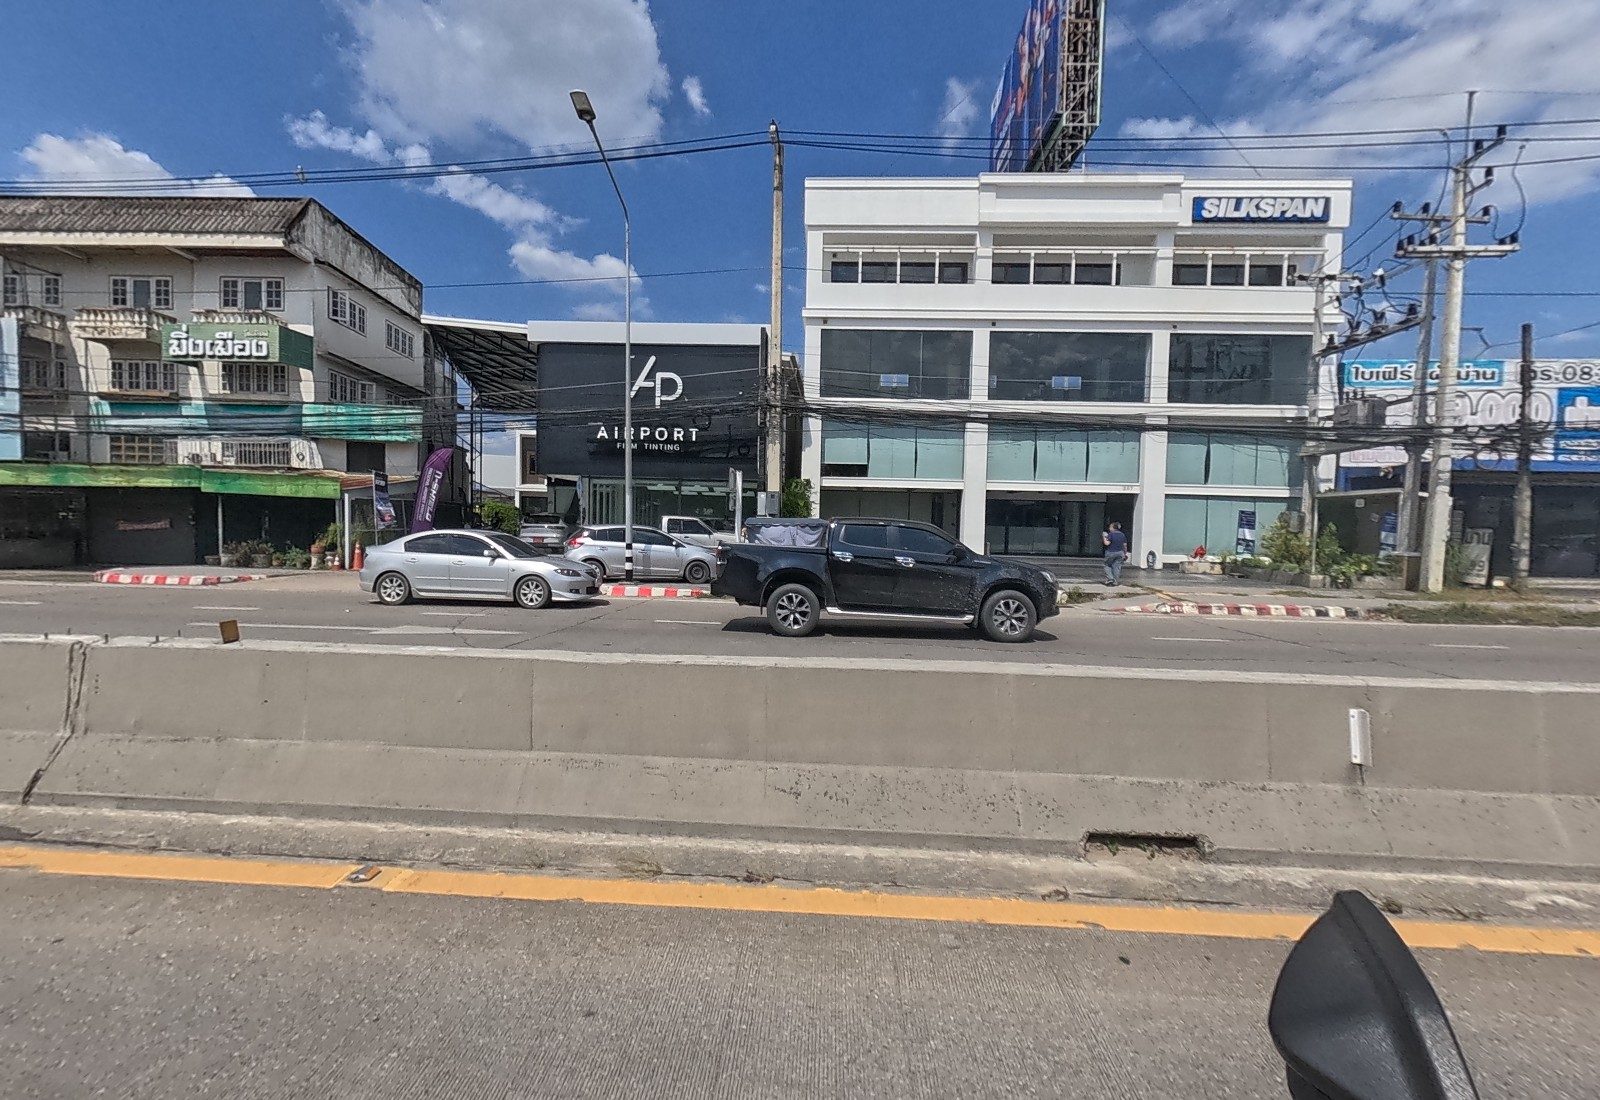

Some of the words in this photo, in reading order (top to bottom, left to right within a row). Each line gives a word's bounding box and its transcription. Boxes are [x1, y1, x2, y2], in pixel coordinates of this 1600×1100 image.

[1201, 198, 1325, 218] SILKSPAN
[168, 324, 268, 356] มิ่งเมือง
[1352, 364, 1414, 380] ใบเฟิร์
[617, 442, 638, 450] FIM
[644, 443, 680, 451] TINTING
